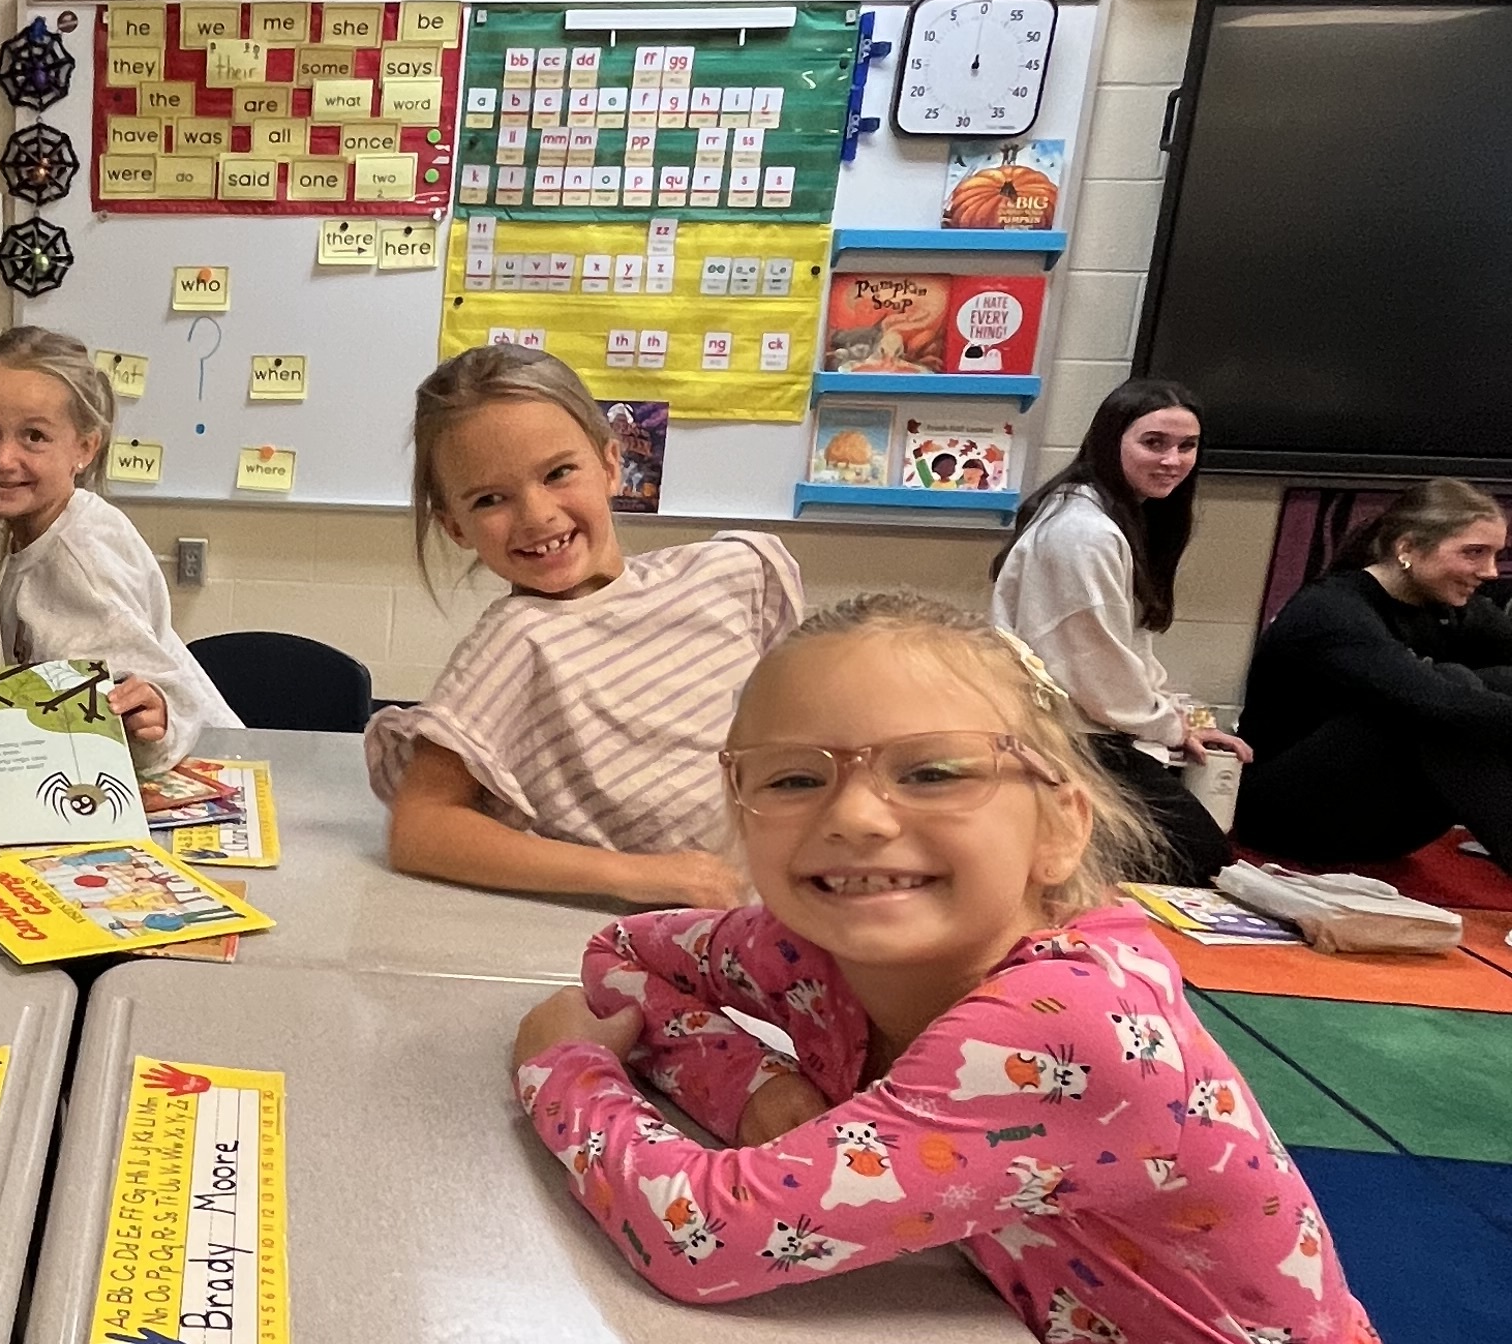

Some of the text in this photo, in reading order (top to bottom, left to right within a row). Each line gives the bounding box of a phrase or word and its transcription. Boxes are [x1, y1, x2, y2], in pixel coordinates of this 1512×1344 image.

[981, 3, 1023, 21] 0 55
[126, 14, 443, 36] he we me she be
[1027, 31, 1040, 42] 50
[113, 59, 432, 78] they their some says
[510, 53, 688, 70] bb dd gg
[1026, 59, 1040, 71] 45
[150, 93, 430, 113] the are what word
[956, 116, 971, 128] 30
[113, 129, 393, 150] have was all once
[108, 167, 395, 187] were said one two
[1016, 197, 1049, 209] BIG
[326, 231, 430, 255] there here
[181, 278, 220, 292] who
[855, 280, 927, 298] Pumpkin
[873, 294, 912, 313] Soup
[976, 297, 1008, 309] I HATE
[970, 310, 1009, 324] EVERY
[970, 326, 1007, 338] THING!
[709, 338, 784, 352] ng ck
[255, 368, 301, 381] when
[118, 456, 154, 472] why
[246, 463, 286, 476] where
[181, 1140, 253, 1330] Brady Moore
